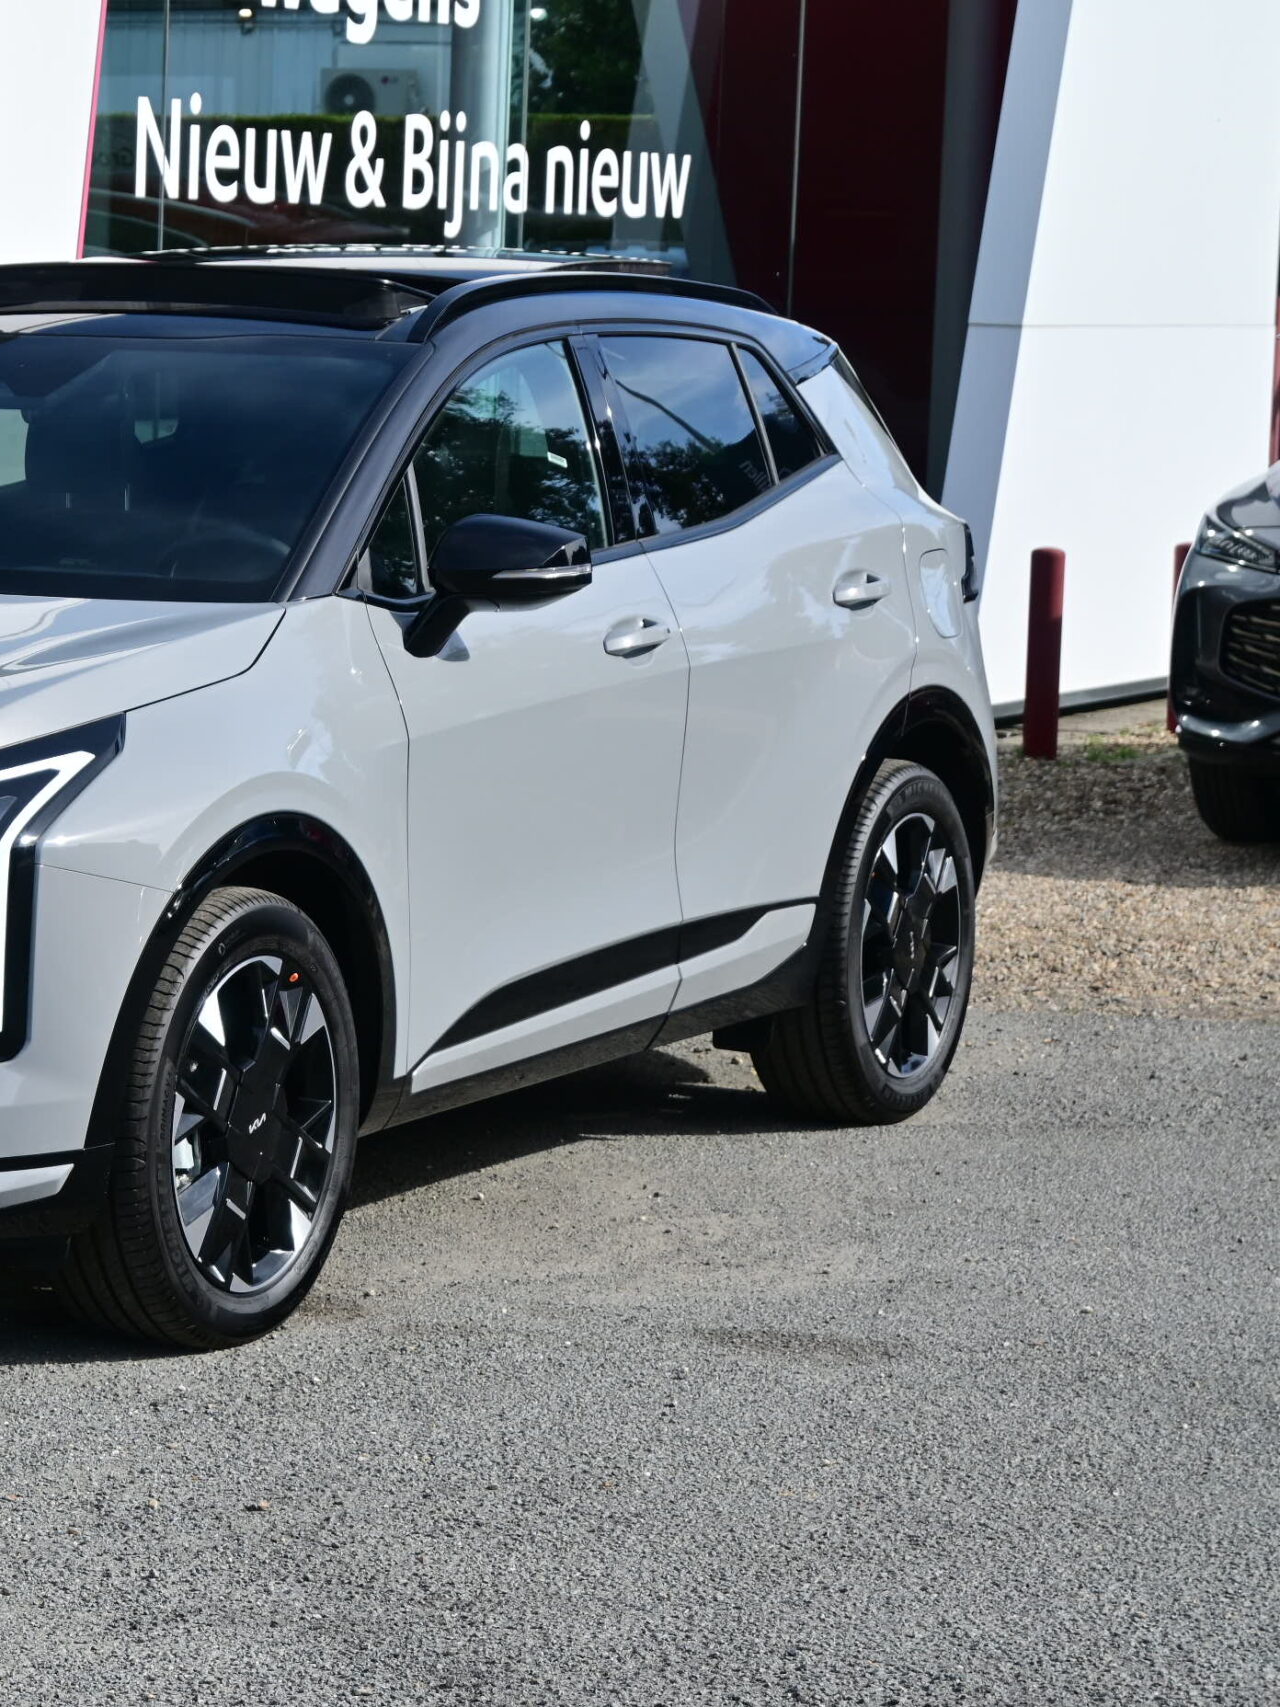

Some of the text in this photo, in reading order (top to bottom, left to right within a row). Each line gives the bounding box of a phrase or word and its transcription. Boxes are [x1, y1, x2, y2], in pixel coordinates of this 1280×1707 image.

[134, 92, 692, 237] Nieuw & Bijna nieuw
